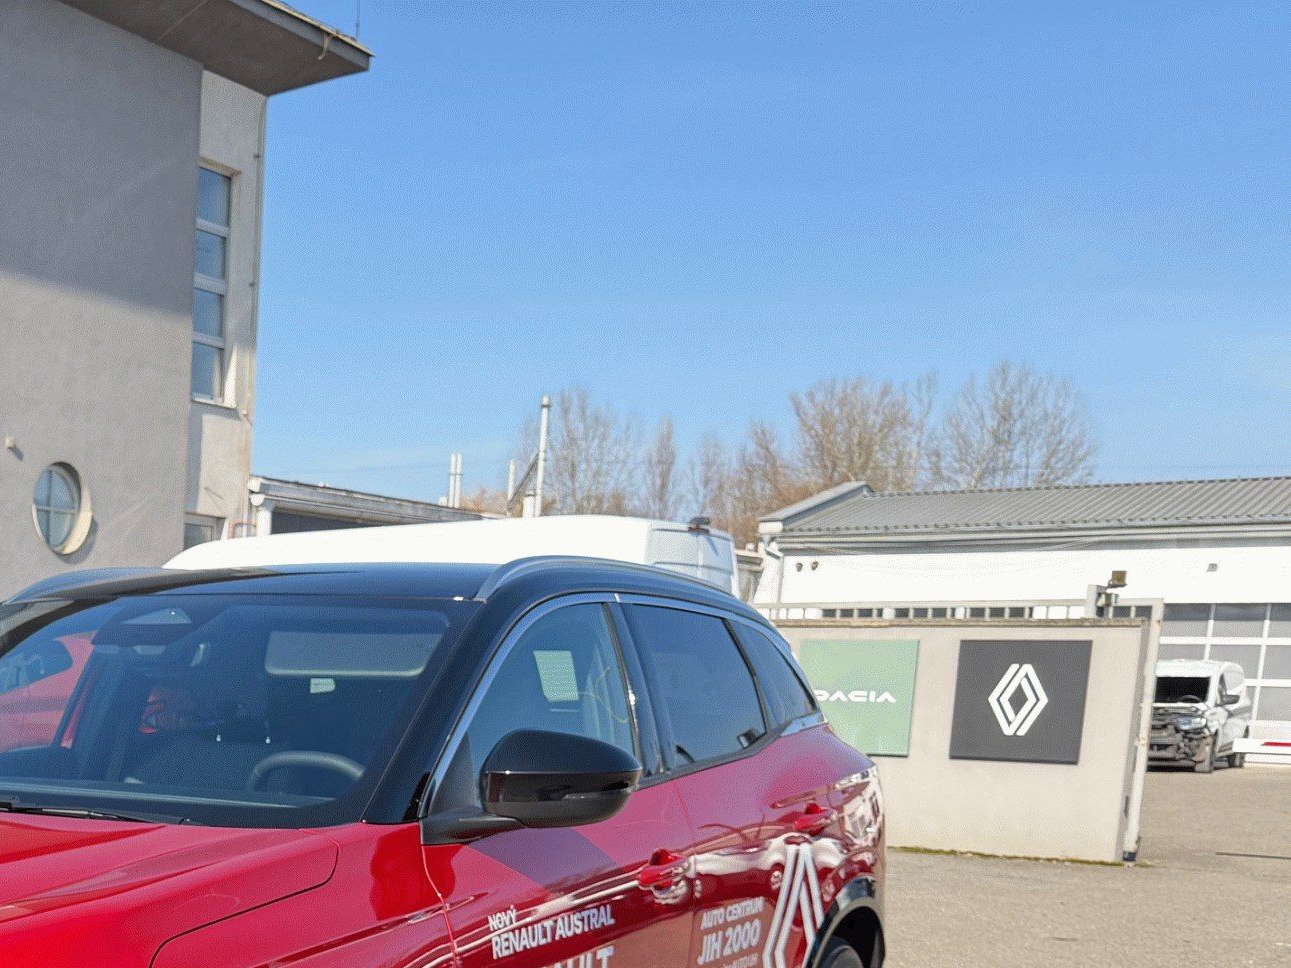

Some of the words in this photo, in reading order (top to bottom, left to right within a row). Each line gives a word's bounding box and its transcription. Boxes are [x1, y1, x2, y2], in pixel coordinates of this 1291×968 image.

[813, 689, 896, 703] DACIA
[487, 904, 517, 931] NOVÝ
[700, 907, 725, 930] AUTO
[726, 896, 765, 922] CENTRUM
[491, 920, 554, 959] RENAULT
[555, 904, 615, 940] AUSTRAL
[697, 930, 724, 965] JIH
[723, 918, 761, 956] 2000
